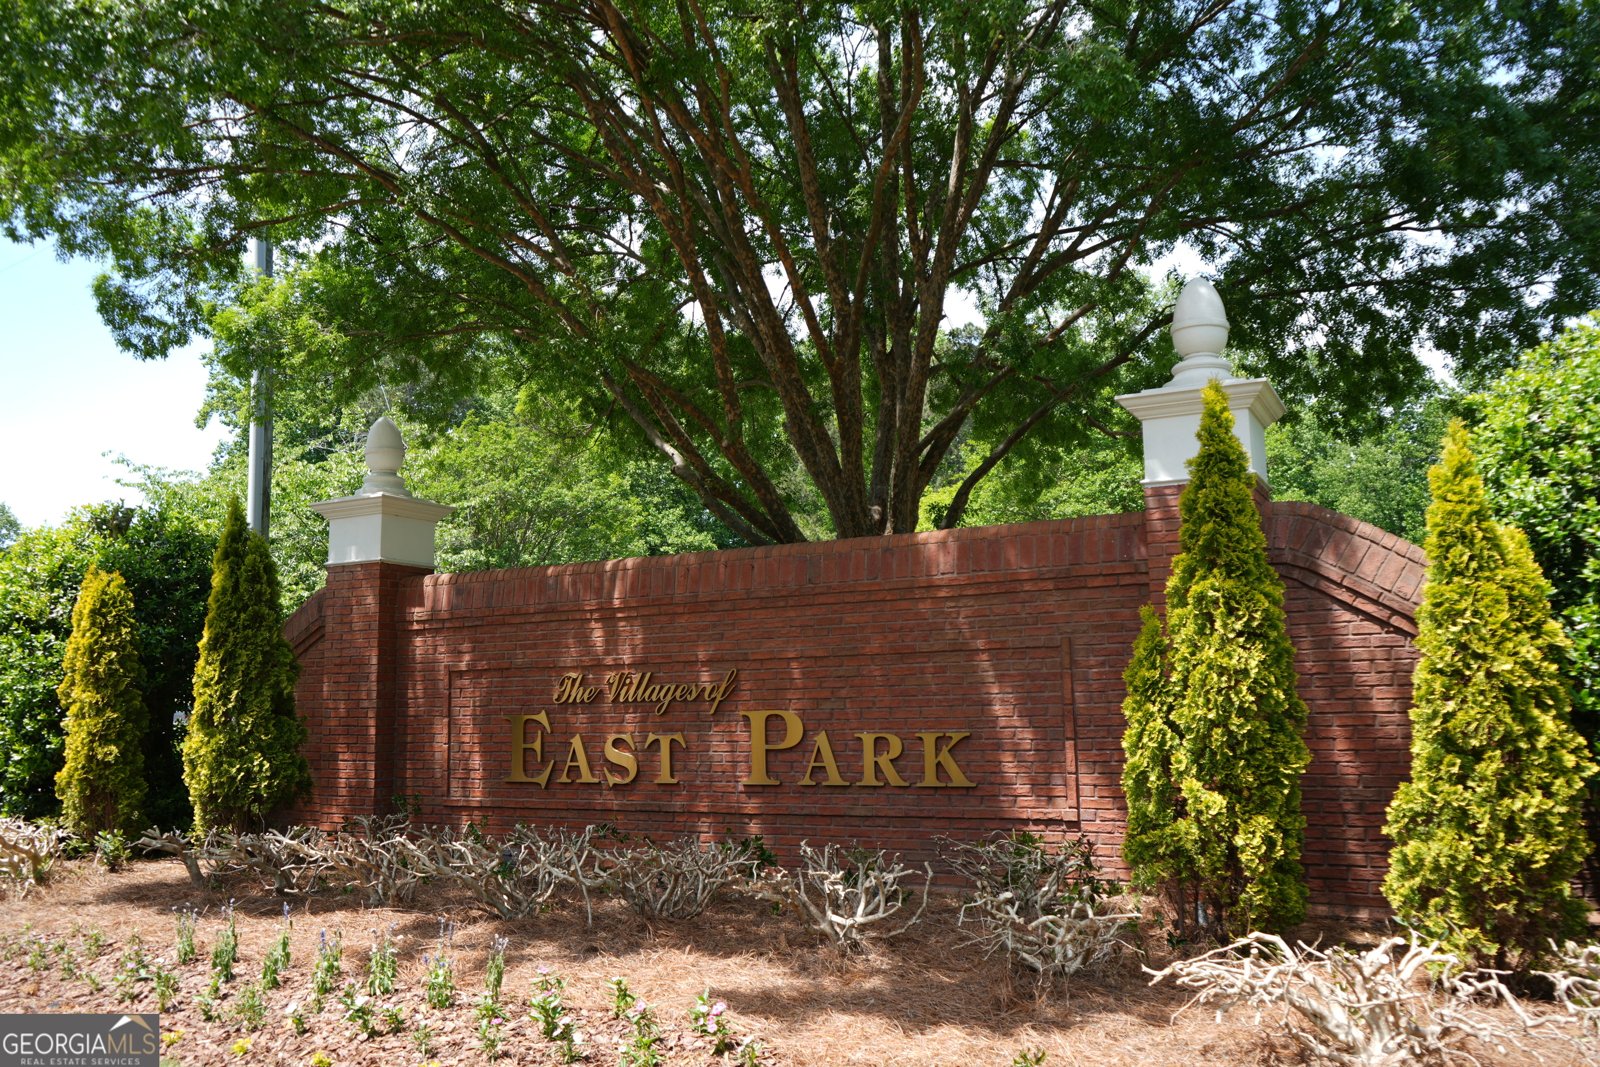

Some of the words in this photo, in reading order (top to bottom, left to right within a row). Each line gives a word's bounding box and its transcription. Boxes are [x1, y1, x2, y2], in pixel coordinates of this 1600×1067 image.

[553, 672, 601, 704] The
[605, 671, 702, 715] Villages
[703, 668, 738, 715] of
[503, 709, 687, 789] EAST
[740, 710, 977, 787] PARK
